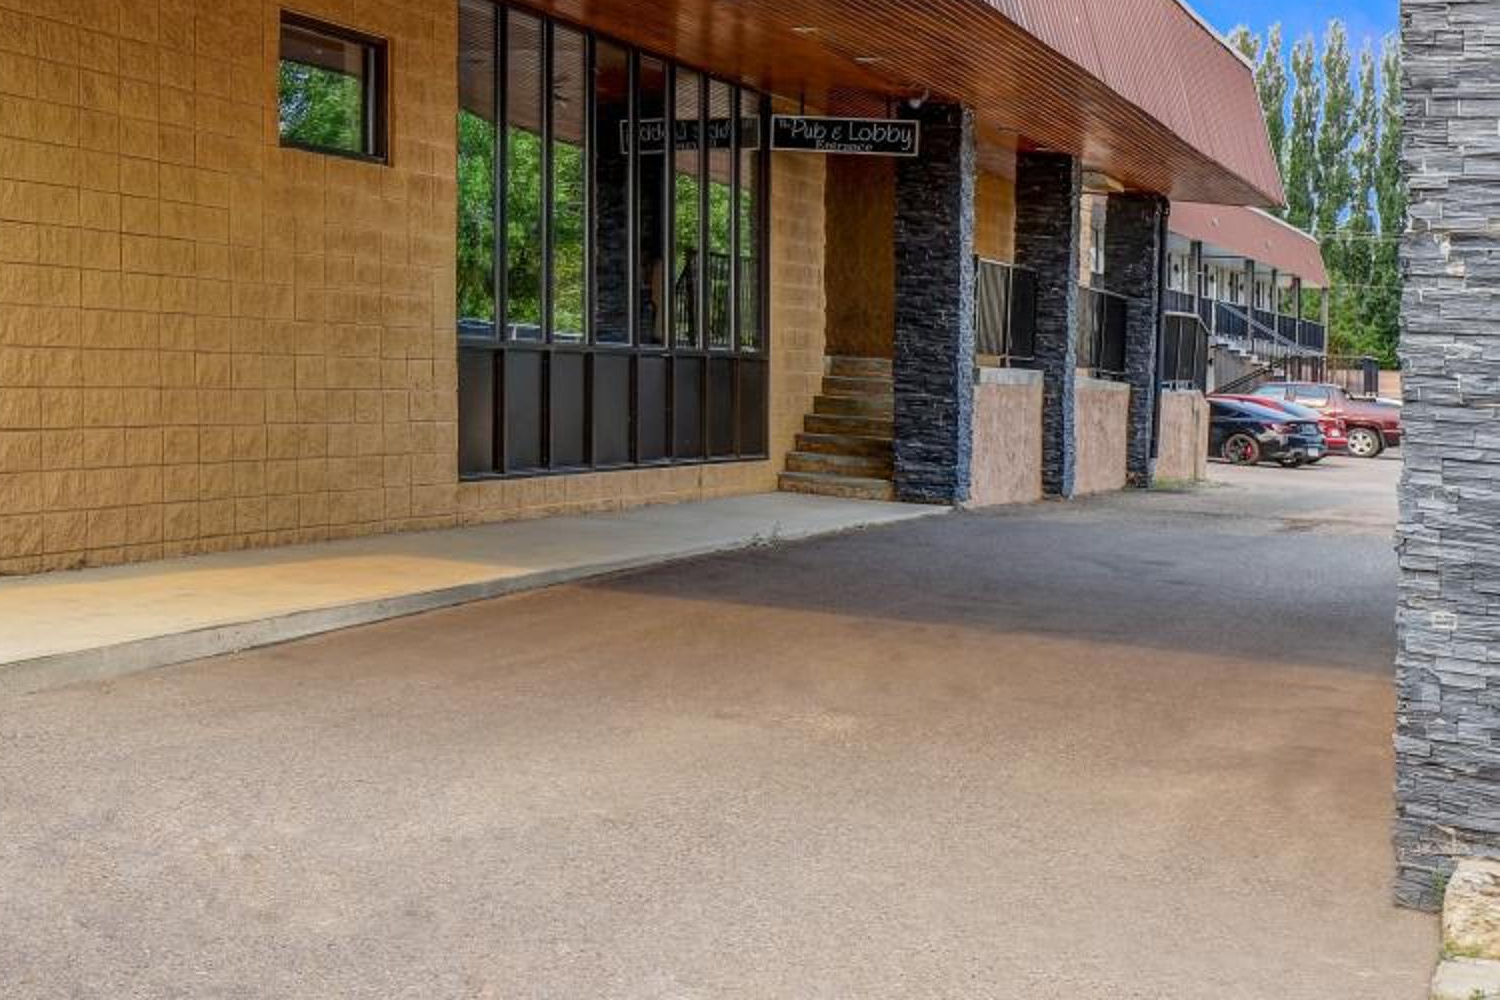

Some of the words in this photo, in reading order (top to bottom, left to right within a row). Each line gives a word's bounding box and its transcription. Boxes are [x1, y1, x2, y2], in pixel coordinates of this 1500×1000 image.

[791, 119, 827, 139] Pub
[849, 121, 912, 151] Lobby
[816, 139, 873, 152] Entrance
